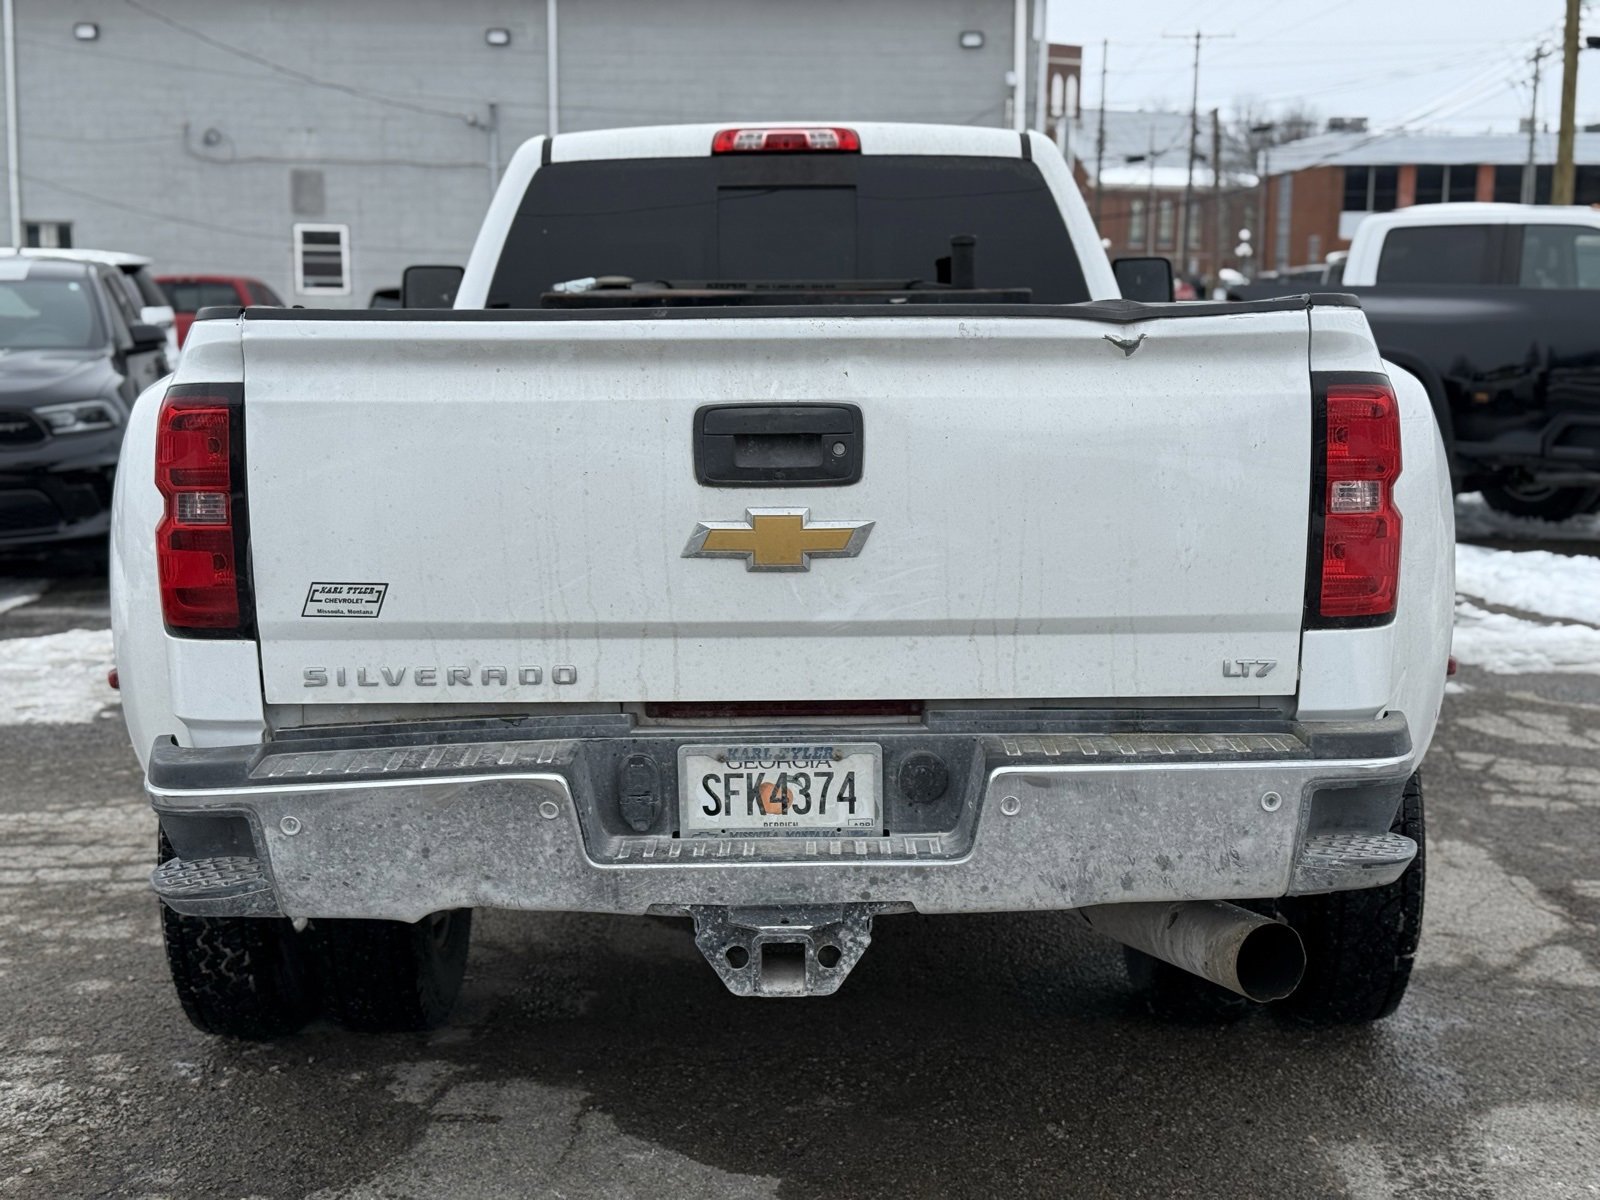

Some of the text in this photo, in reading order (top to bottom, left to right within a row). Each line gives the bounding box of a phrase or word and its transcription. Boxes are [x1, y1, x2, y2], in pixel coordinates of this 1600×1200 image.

[319, 586, 375, 595] KARL TYLER
[303, 665, 578, 688] SILVERADO
[727, 747, 834, 760] KARL TYLER
[726, 760, 832, 770] GEORGIA
[701, 771, 857, 816] SFK4374
